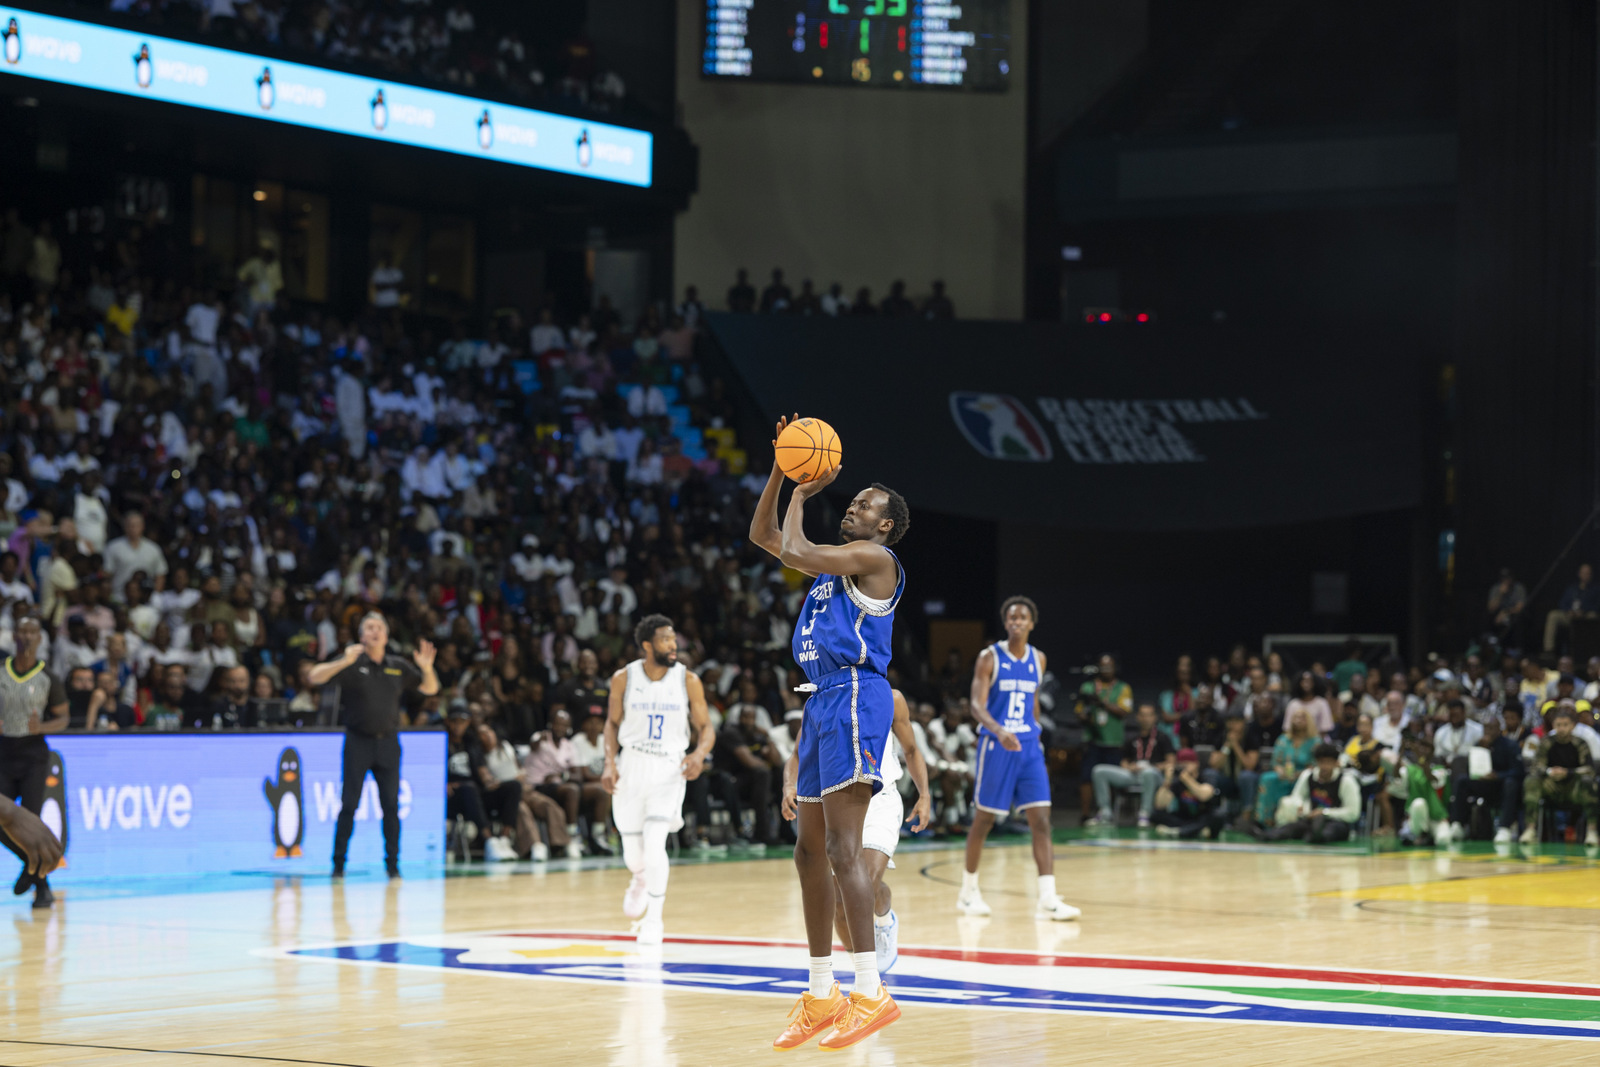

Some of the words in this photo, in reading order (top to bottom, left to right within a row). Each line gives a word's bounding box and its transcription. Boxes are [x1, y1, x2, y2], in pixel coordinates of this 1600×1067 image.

[25, 33, 82, 64] wave
[1037, 397, 1268, 422] BASKETBALL
[1008, 692, 1025, 719] 15
[647, 714, 664, 740] 13
[80, 783, 193, 830] wave
